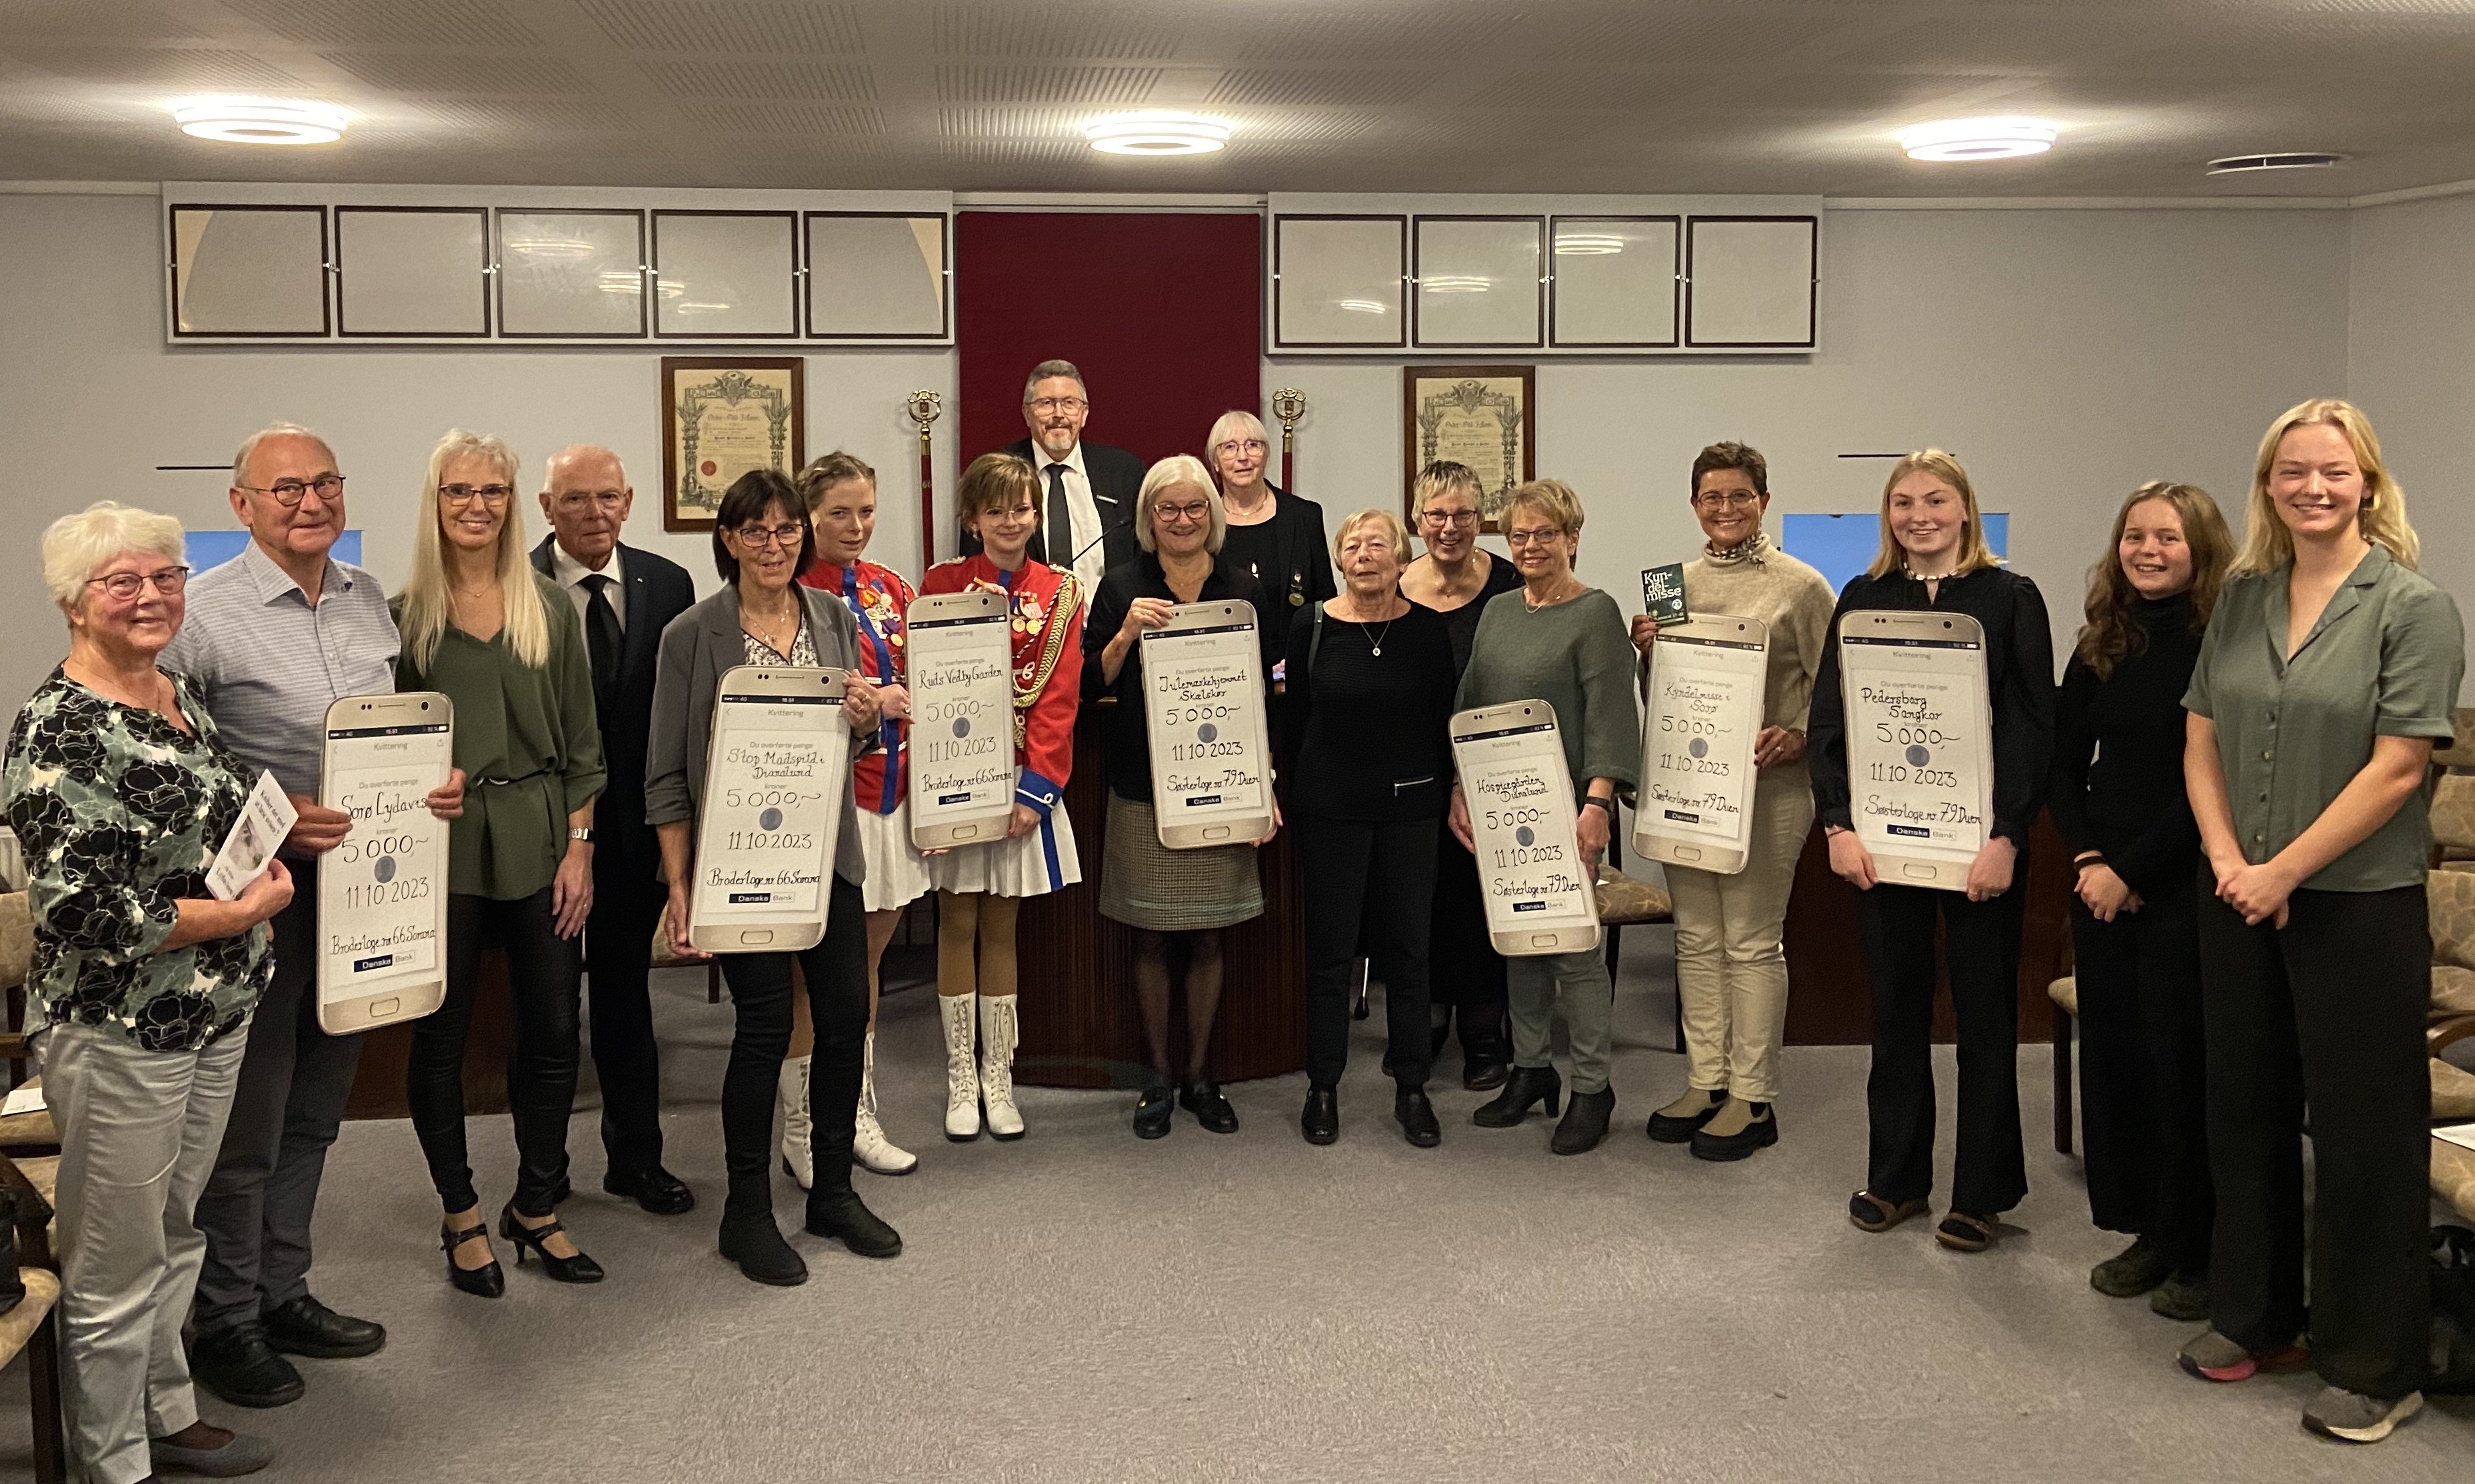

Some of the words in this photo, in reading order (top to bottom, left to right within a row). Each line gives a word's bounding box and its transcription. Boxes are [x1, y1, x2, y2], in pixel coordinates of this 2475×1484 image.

[1644, 572, 1672, 585] Kyn-
[1646, 588, 1681, 601] misse
[1648, 580, 1669, 594] del-
[1893, 651, 1931, 660] Kvittering
[919, 669, 945, 689] Ruds
[945, 669, 971, 688] Vedby
[973, 664, 1003, 680] Garden
[1159, 669, 1246, 692] Julemærkehjemmet
[1179, 688, 1227, 701] Skælskør
[1664, 682, 1723, 700] Kyndelmisse
[1861, 687, 1927, 709] Pedersborg
[1689, 700, 1718, 714] Sorø
[1889, 705, 1942, 722] Sangkor
[727, 748, 760, 766] Stop
[764, 752, 818, 766] Madspild
[753, 766, 813, 779] Dianalund
[976, 769, 988, 784] 66
[1223, 770, 1237, 786] 79
[1238, 772, 1260, 786] Duen
[1500, 783, 1548, 802] Dianalund
[342, 794, 372, 822] Sorø
[377, 792, 427, 823] Lydavis
[1703, 793, 1716, 809] 79
[1716, 796, 1739, 813] Duen
[1672, 813, 1698, 822] Danske
[1940, 802, 1958, 822] 79
[1958, 806, 1982, 824] Duen
[1896, 827, 1928, 836] Danske
[777, 870, 790, 885] 66
[1546, 874, 1560, 893] 79
[1561, 876, 1581, 892] Duen
[393, 926, 405, 944] 66
[363, 959, 391, 968] Danske
